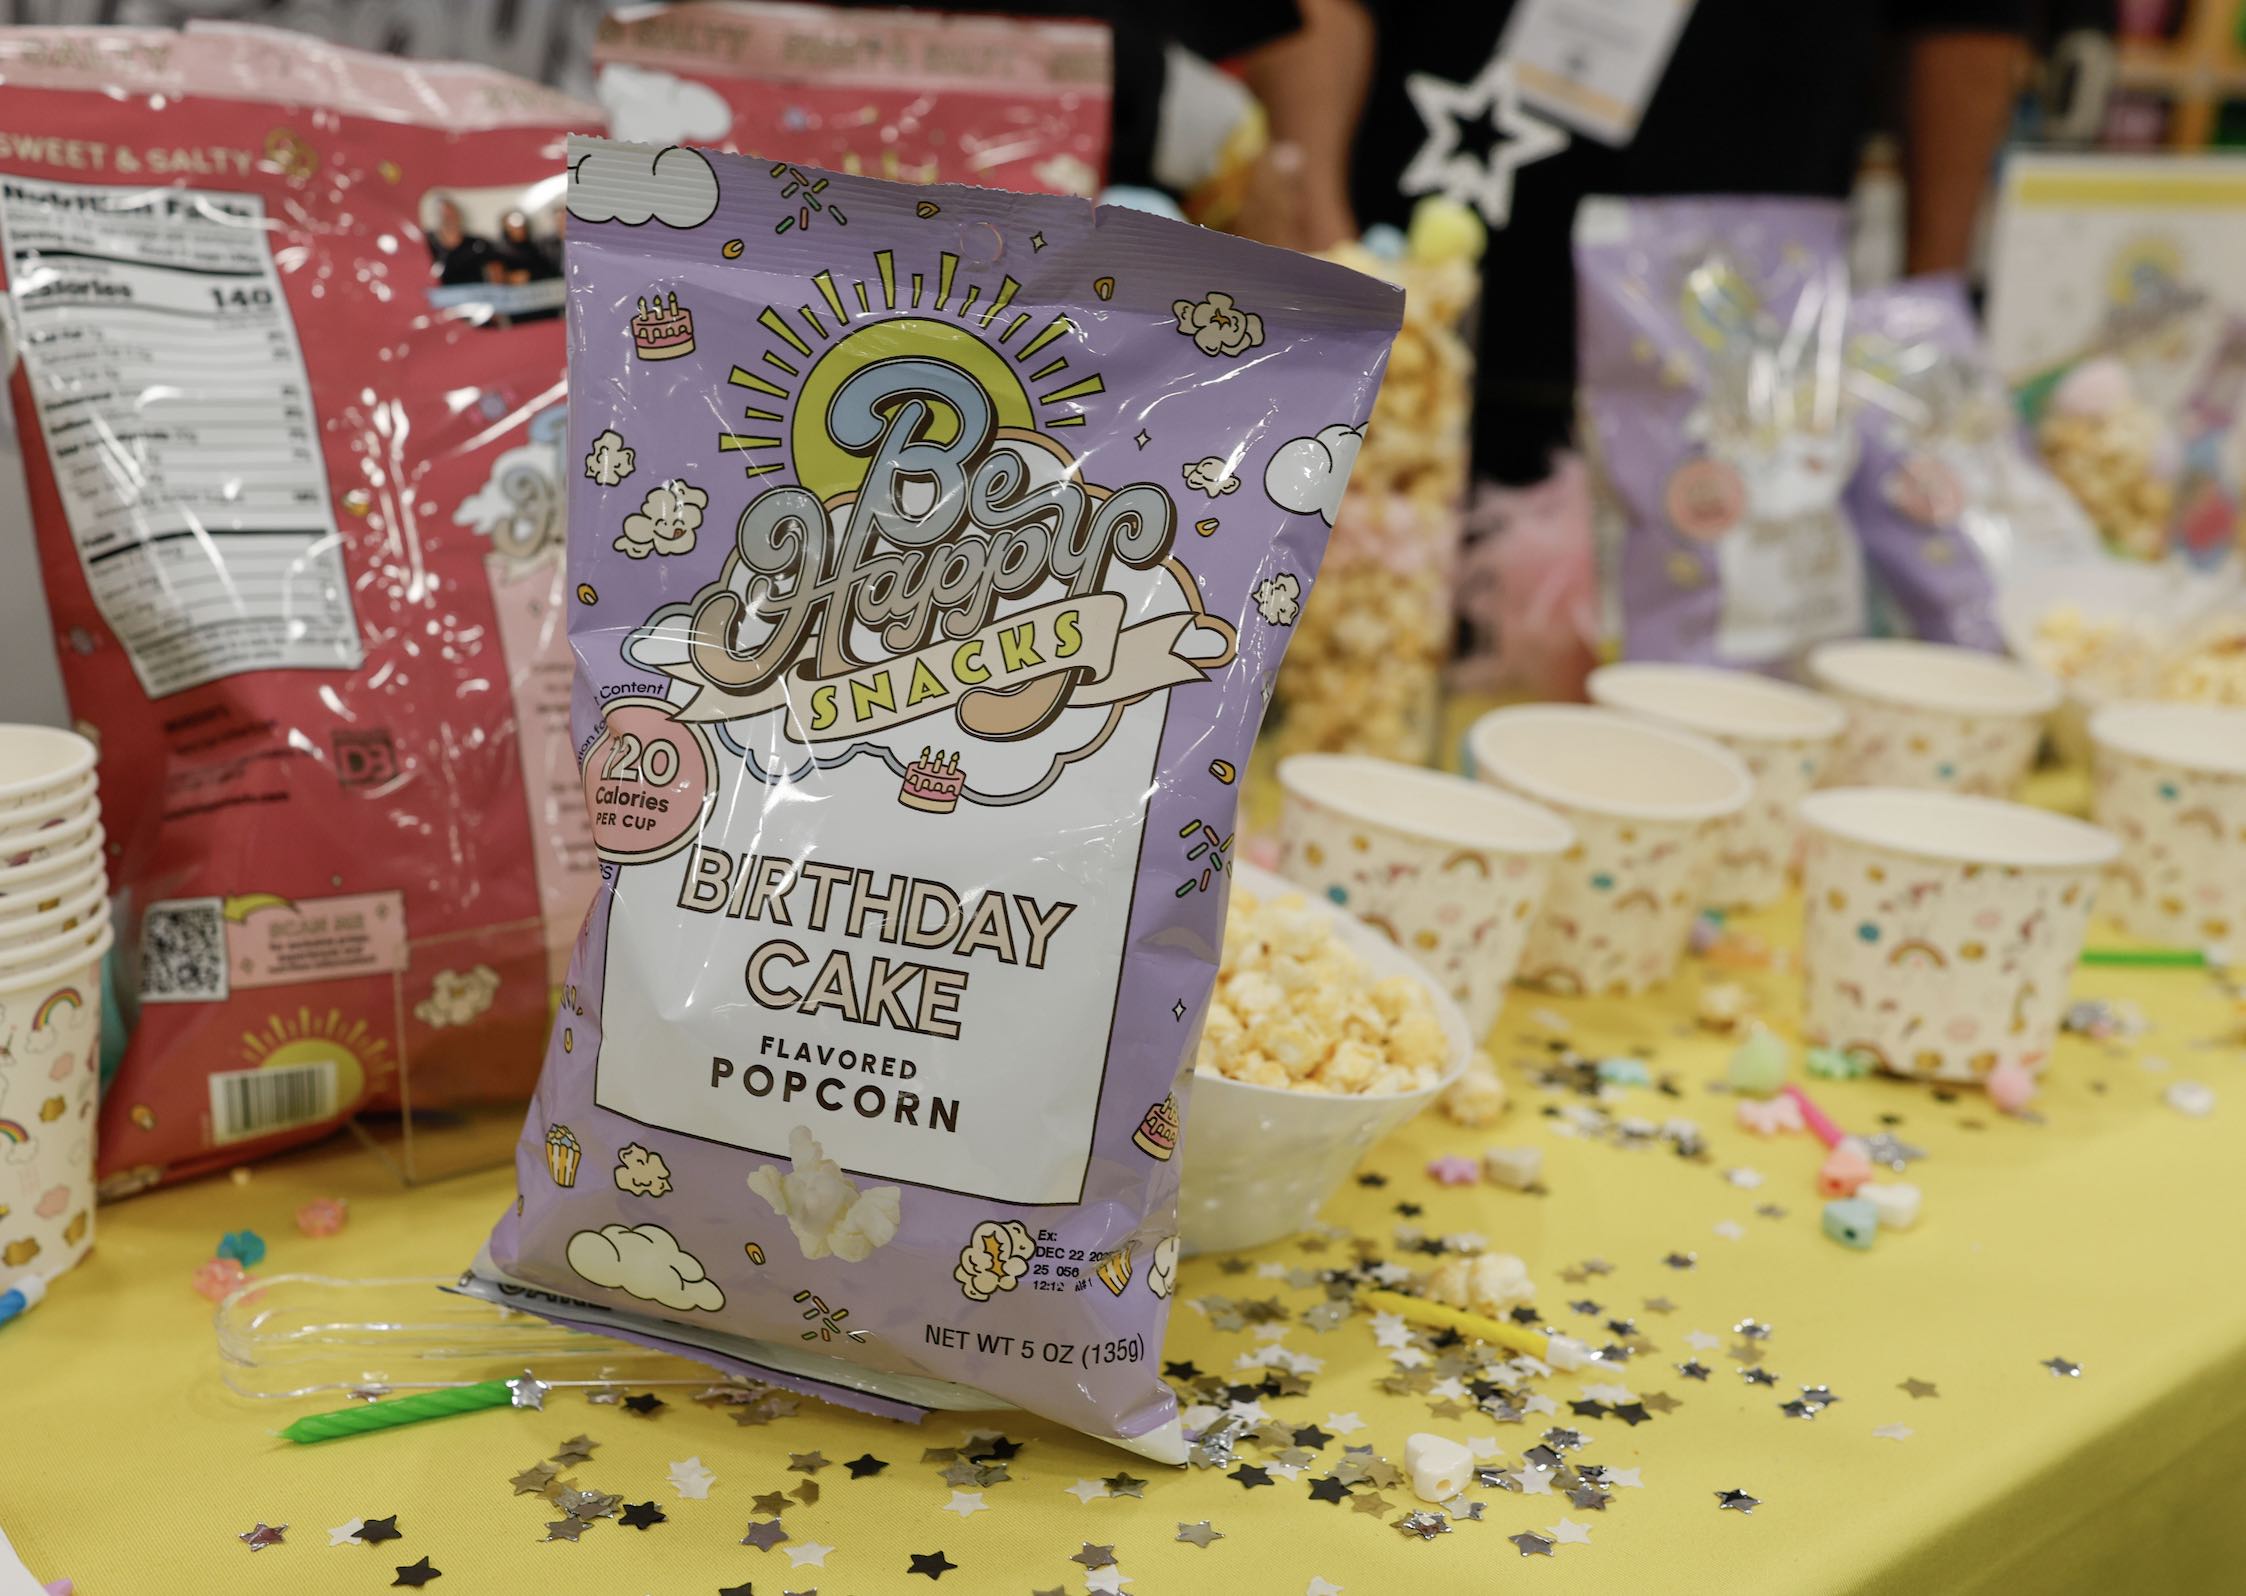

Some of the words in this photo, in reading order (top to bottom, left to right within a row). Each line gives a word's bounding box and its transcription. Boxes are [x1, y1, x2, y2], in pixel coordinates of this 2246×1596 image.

[0, 132, 107, 170] SWEET
[115, 145, 142, 173] &
[146, 147, 253, 178] SALTY
[210, 286, 273, 308] 140
[826, 355, 1030, 550] Be
[688, 484, 1178, 740] Happy
[600, 681, 665, 700] Content
[810, 609, 1084, 732] SNACKS
[599, 732, 680, 788] 120
[594, 785, 670, 814] Calories
[595, 812, 617, 827] PER
[622, 814, 657, 832] CUP
[676, 844, 1078, 970] BIRTHDAY
[744, 938, 970, 1041] CAKE
[760, 1035, 918, 1080] FLAVORED
[710, 1056, 960, 1133] POPCORN
[1035, 1245, 1065, 1260] DEC
[1068, 1249, 1085, 1261] 22
[1037, 1229, 1058, 1242] Ex:
[1033, 1264, 1050, 1276] 25
[1033, 1280, 1065, 1292] 12:12
[925, 1324, 970, 1350] NET
[977, 1333, 1015, 1356] WT
[1020, 1340, 1035, 1360] 5
[1042, 1343, 1075, 1365] OZ
[1081, 1332, 1145, 1369] (135g)
